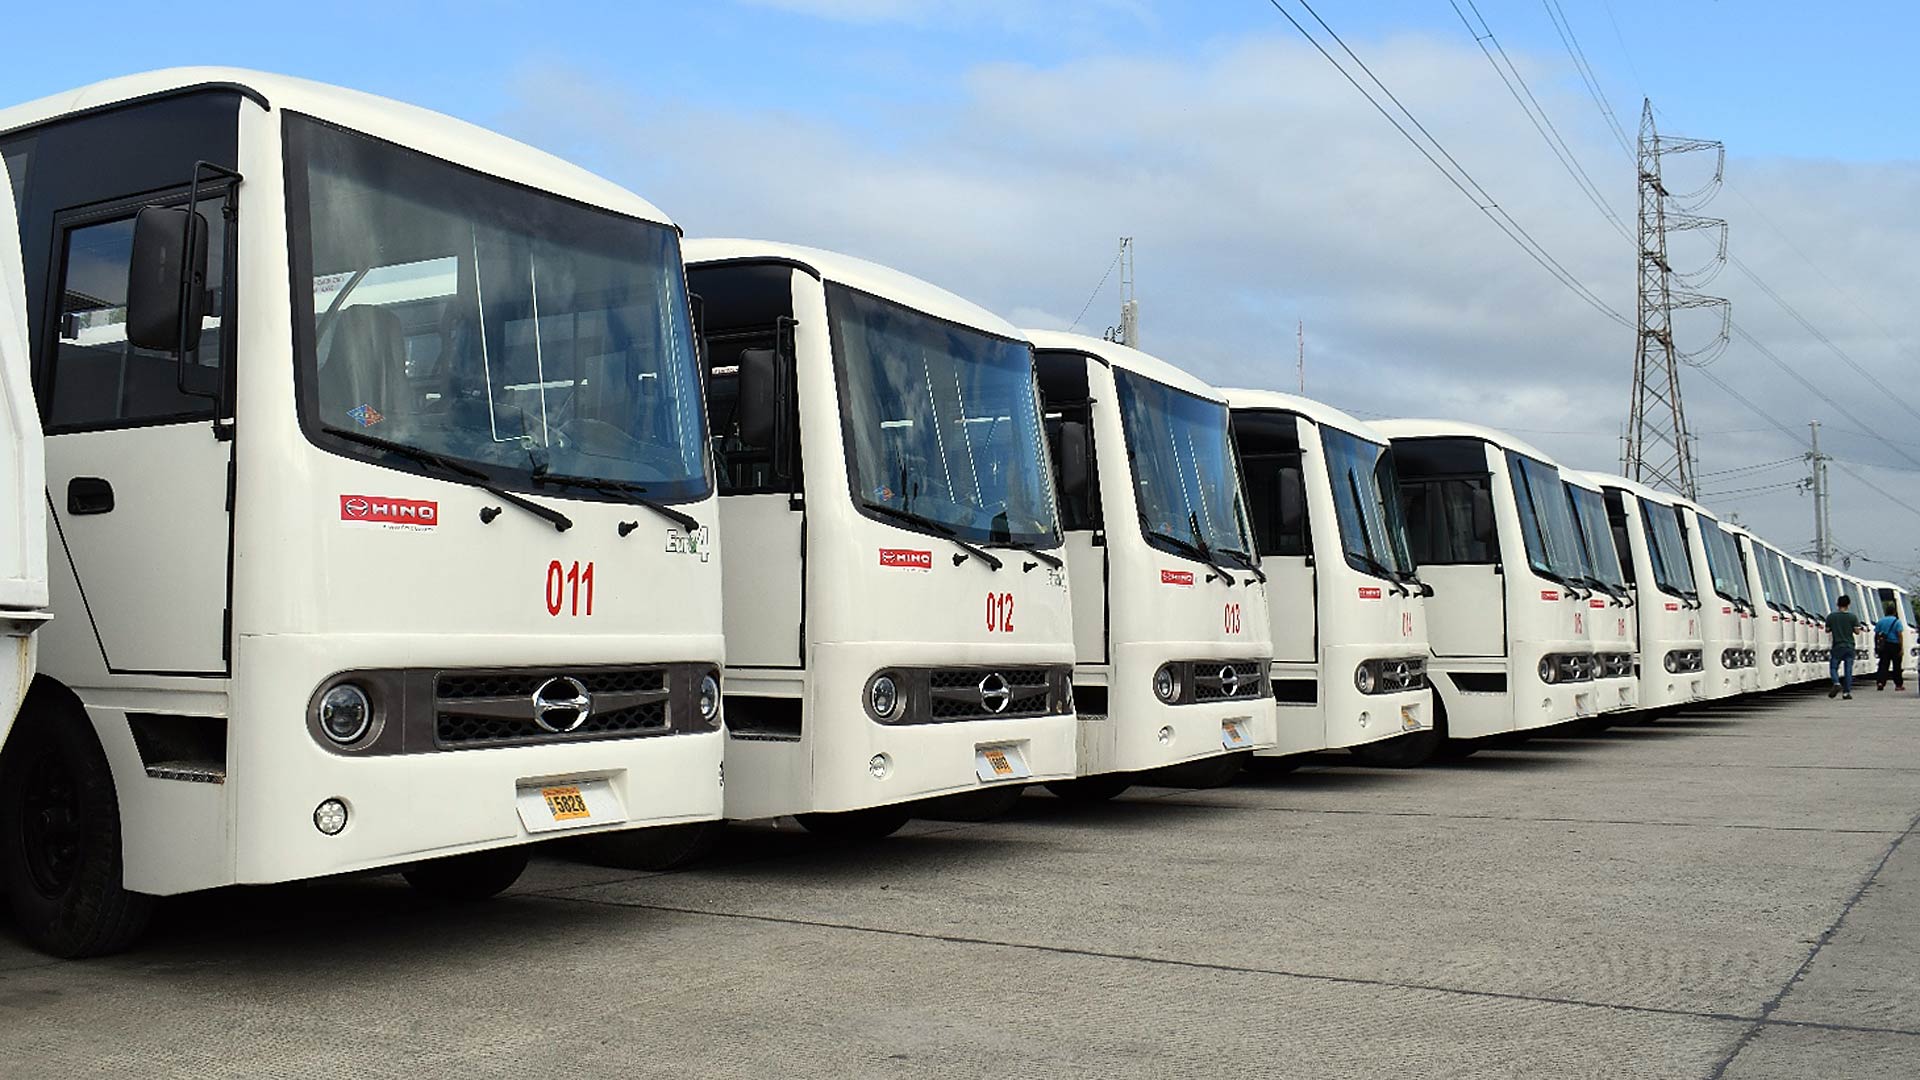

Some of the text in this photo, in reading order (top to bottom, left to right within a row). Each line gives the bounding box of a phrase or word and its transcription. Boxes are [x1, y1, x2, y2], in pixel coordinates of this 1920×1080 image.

[372, 503, 434, 519] HINO
[545, 560, 594, 616] 011
[986, 591, 1014, 632] 012
[1224, 603, 1240, 633] 013
[553, 795, 587, 813] 5828
